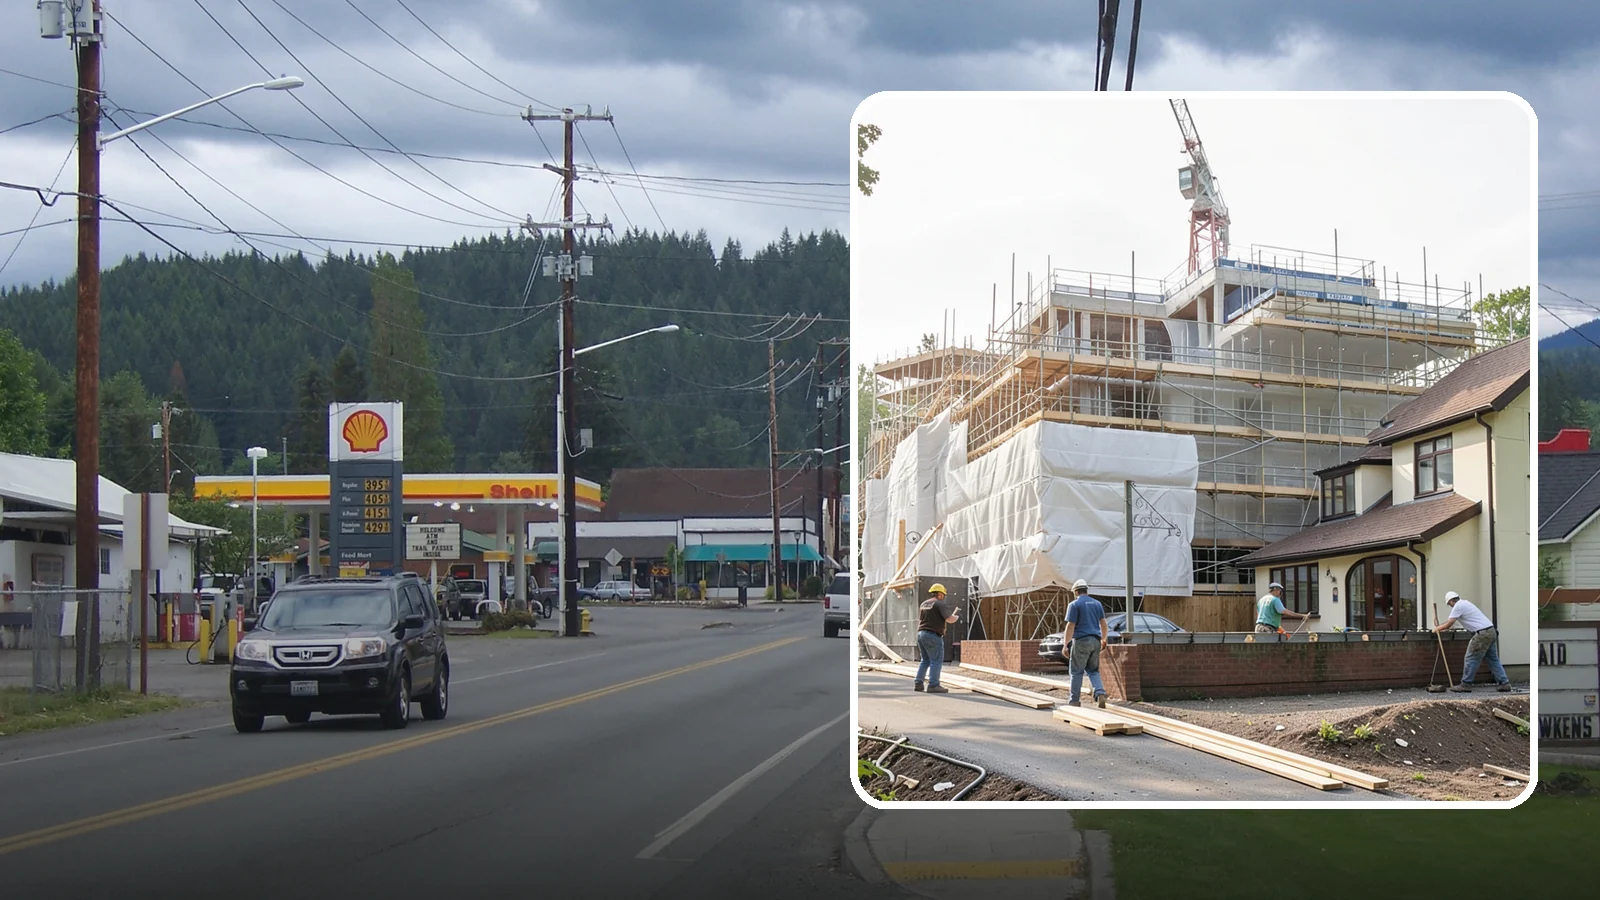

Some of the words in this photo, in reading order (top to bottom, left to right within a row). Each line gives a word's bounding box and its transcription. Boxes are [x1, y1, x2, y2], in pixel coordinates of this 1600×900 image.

[366, 480, 384, 490] 395
[490, 484, 547, 499] Shell
[366, 494, 384, 504] 405
[366, 508, 384, 518] 415
[366, 522, 384, 533] 429
[1539, 643, 1566, 665] AID
